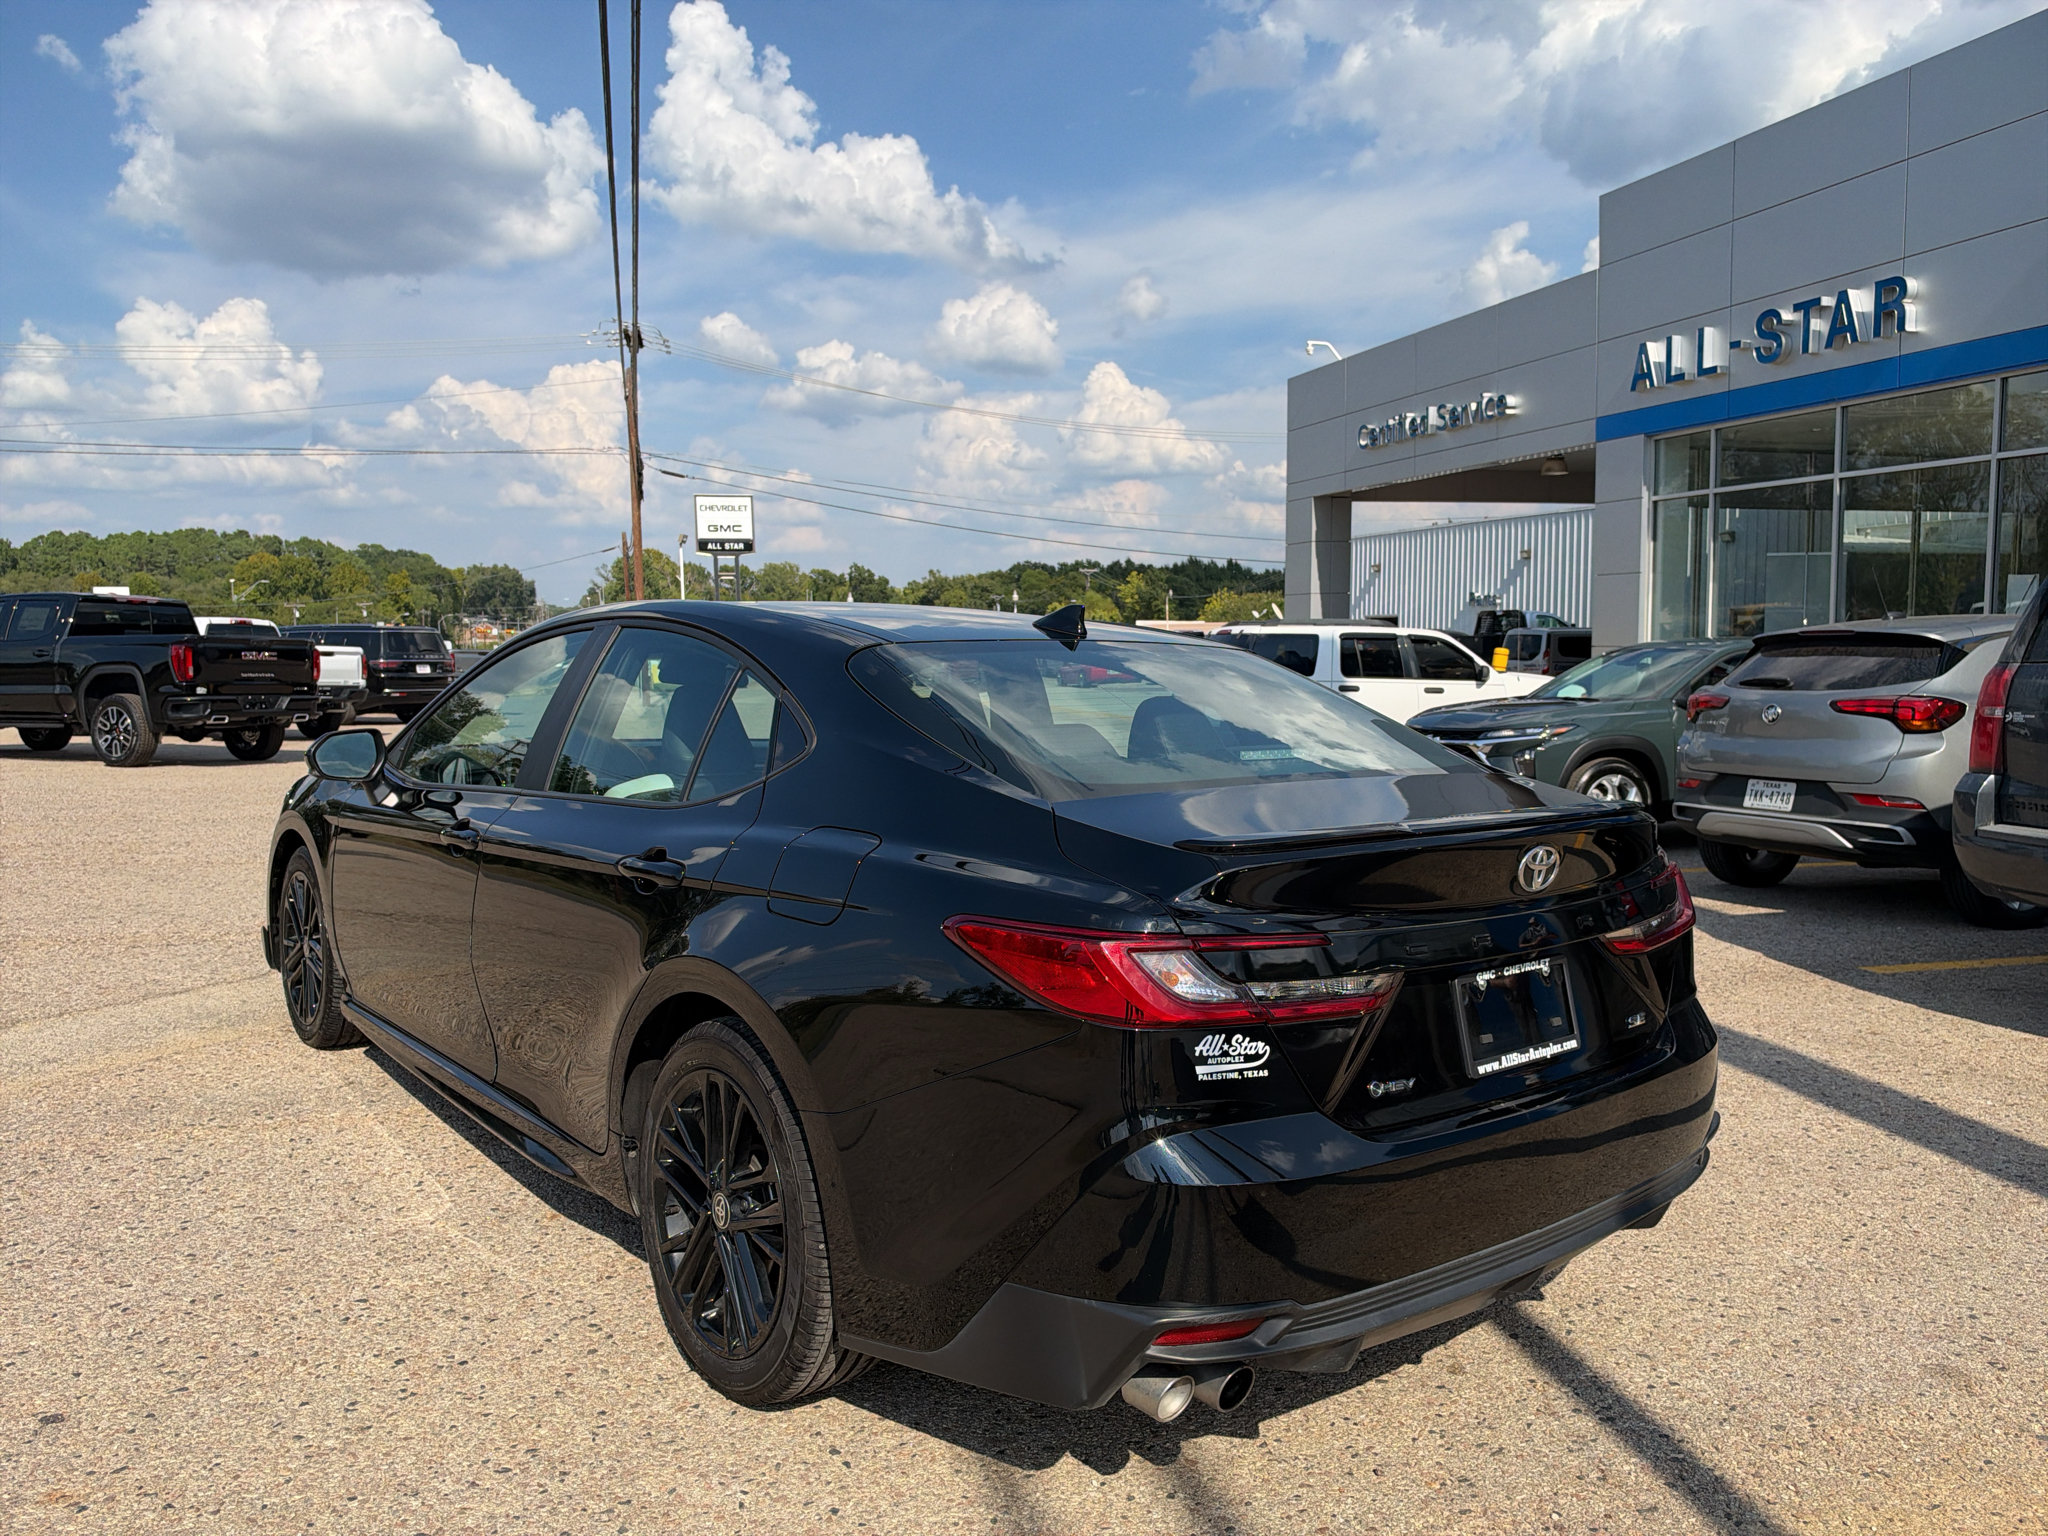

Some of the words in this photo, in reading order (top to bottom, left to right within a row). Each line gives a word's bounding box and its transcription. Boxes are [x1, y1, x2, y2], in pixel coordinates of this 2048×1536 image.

[1436, 392, 1519, 432] Service
[699, 504, 748, 512] CHEVROLET
[707, 524, 743, 533] GMC
[707, 542, 722, 550] ALL
[724, 542, 744, 550] STAR
[1762, 781, 1782, 789] TEXAS
[1476, 969, 1496, 982] GMC
[1503, 958, 1550, 976] CHEVROLET
[1207, 1056, 1245, 1064] AUTOPLEX
[1198, 1071, 1242, 1081] PALESTINE,
[1243, 1069, 1269, 1078] TEXAS
